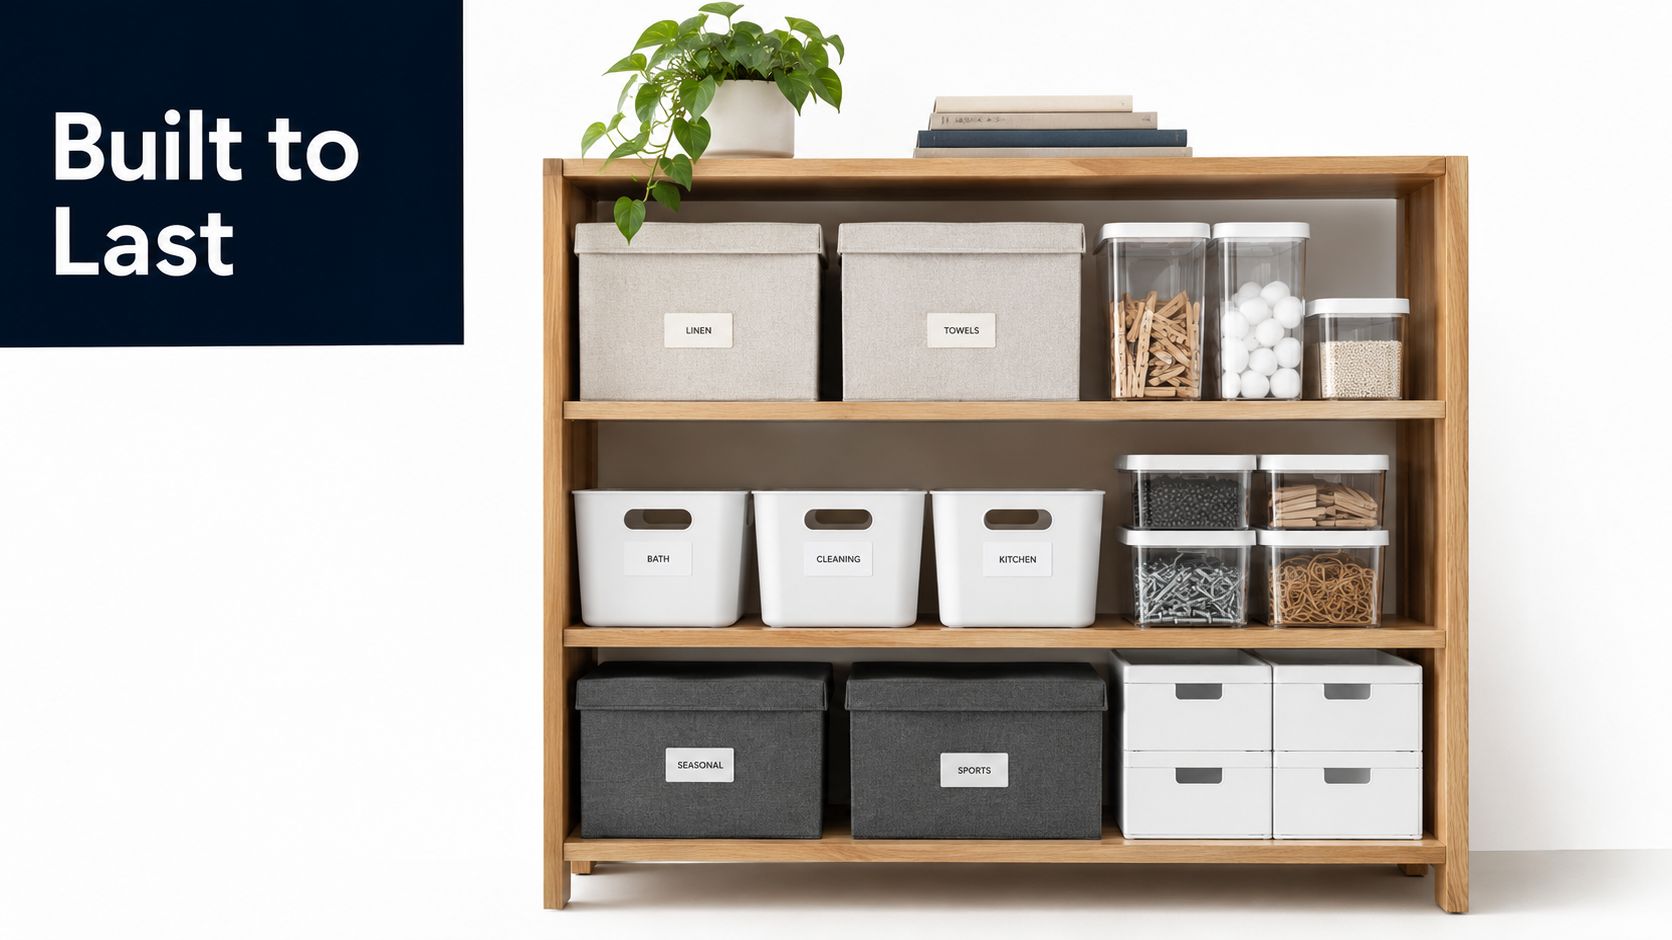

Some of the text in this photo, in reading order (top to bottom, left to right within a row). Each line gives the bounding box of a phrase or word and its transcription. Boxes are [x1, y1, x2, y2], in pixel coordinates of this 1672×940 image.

[685, 326, 712, 335] LINEN
[943, 326, 980, 335] TOWELS
[647, 554, 670, 563] BATH
[816, 555, 861, 564] CLEANING
[999, 555, 1037, 564] KITCHEN
[677, 760, 724, 770] SEASONAL
[957, 766, 992, 775] SPORTS
